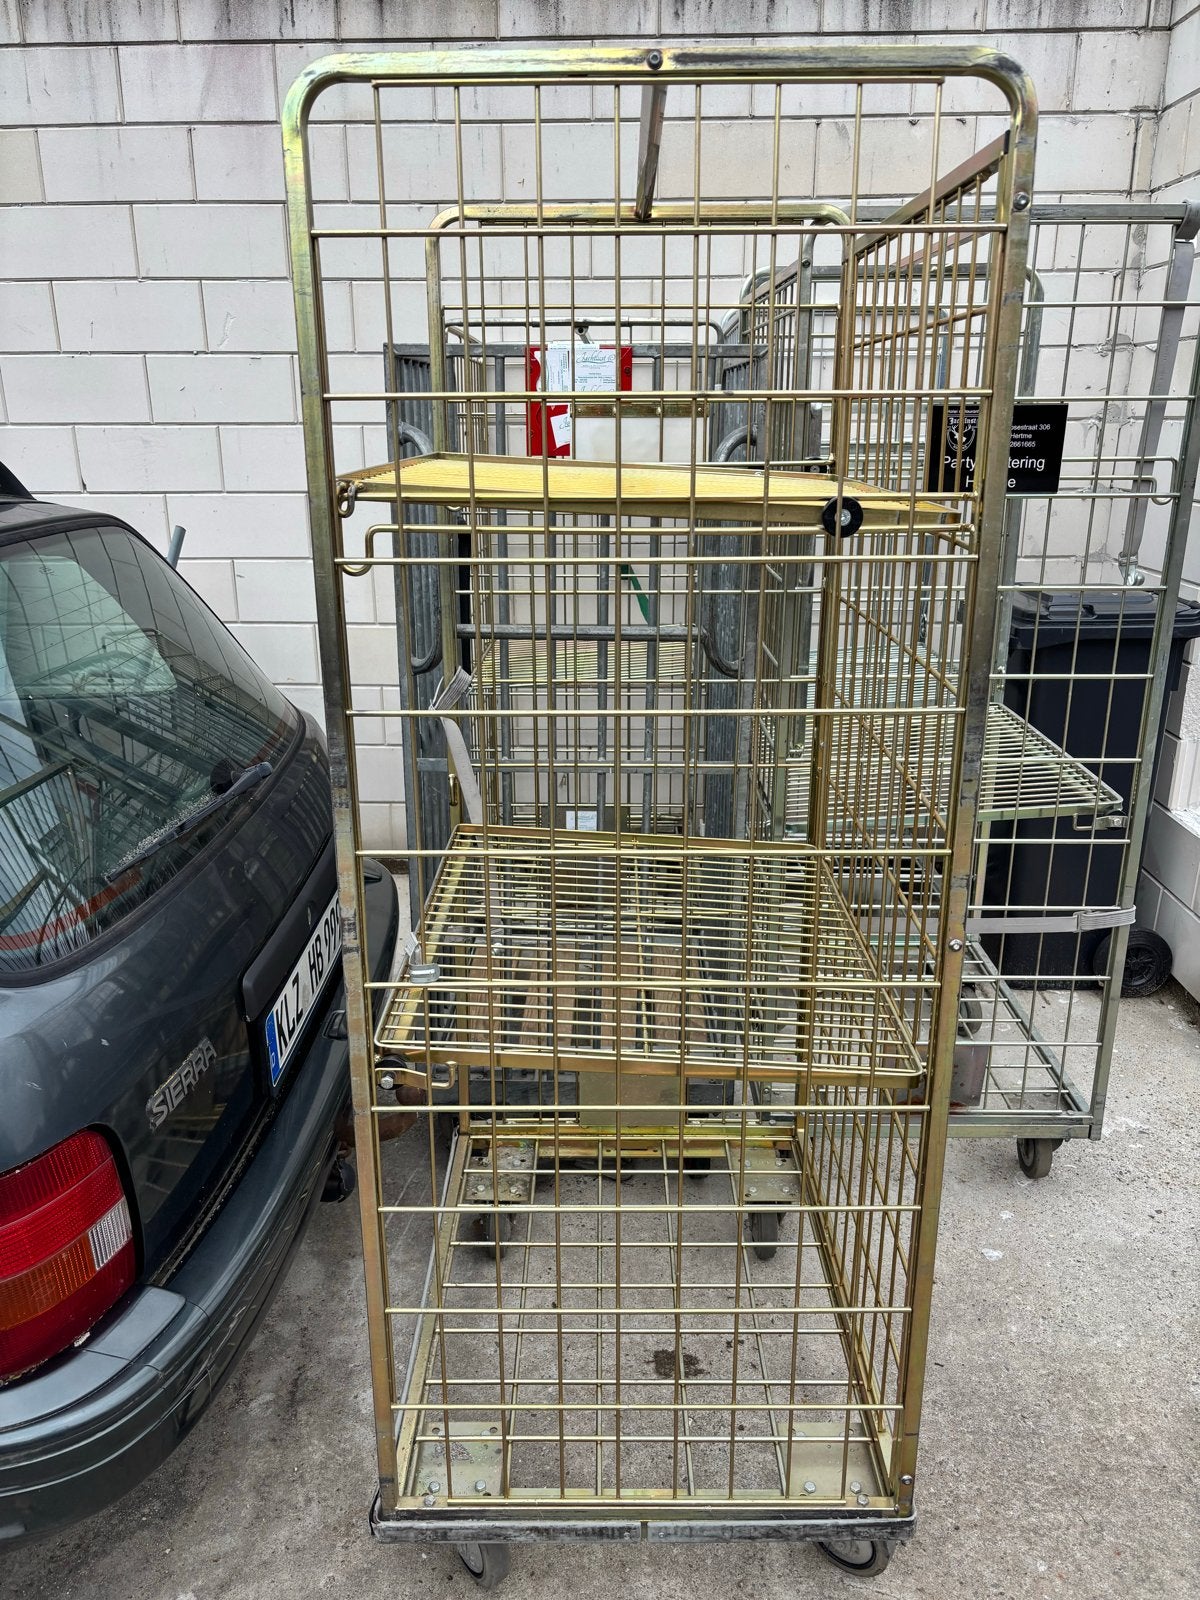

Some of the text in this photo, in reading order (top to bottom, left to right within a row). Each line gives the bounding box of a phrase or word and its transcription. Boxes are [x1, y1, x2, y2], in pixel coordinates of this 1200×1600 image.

[1007, 456, 1046, 472] tering
[274, 972, 304, 1057] KLZ
[146, 1037, 218, 1132] SIERRA
